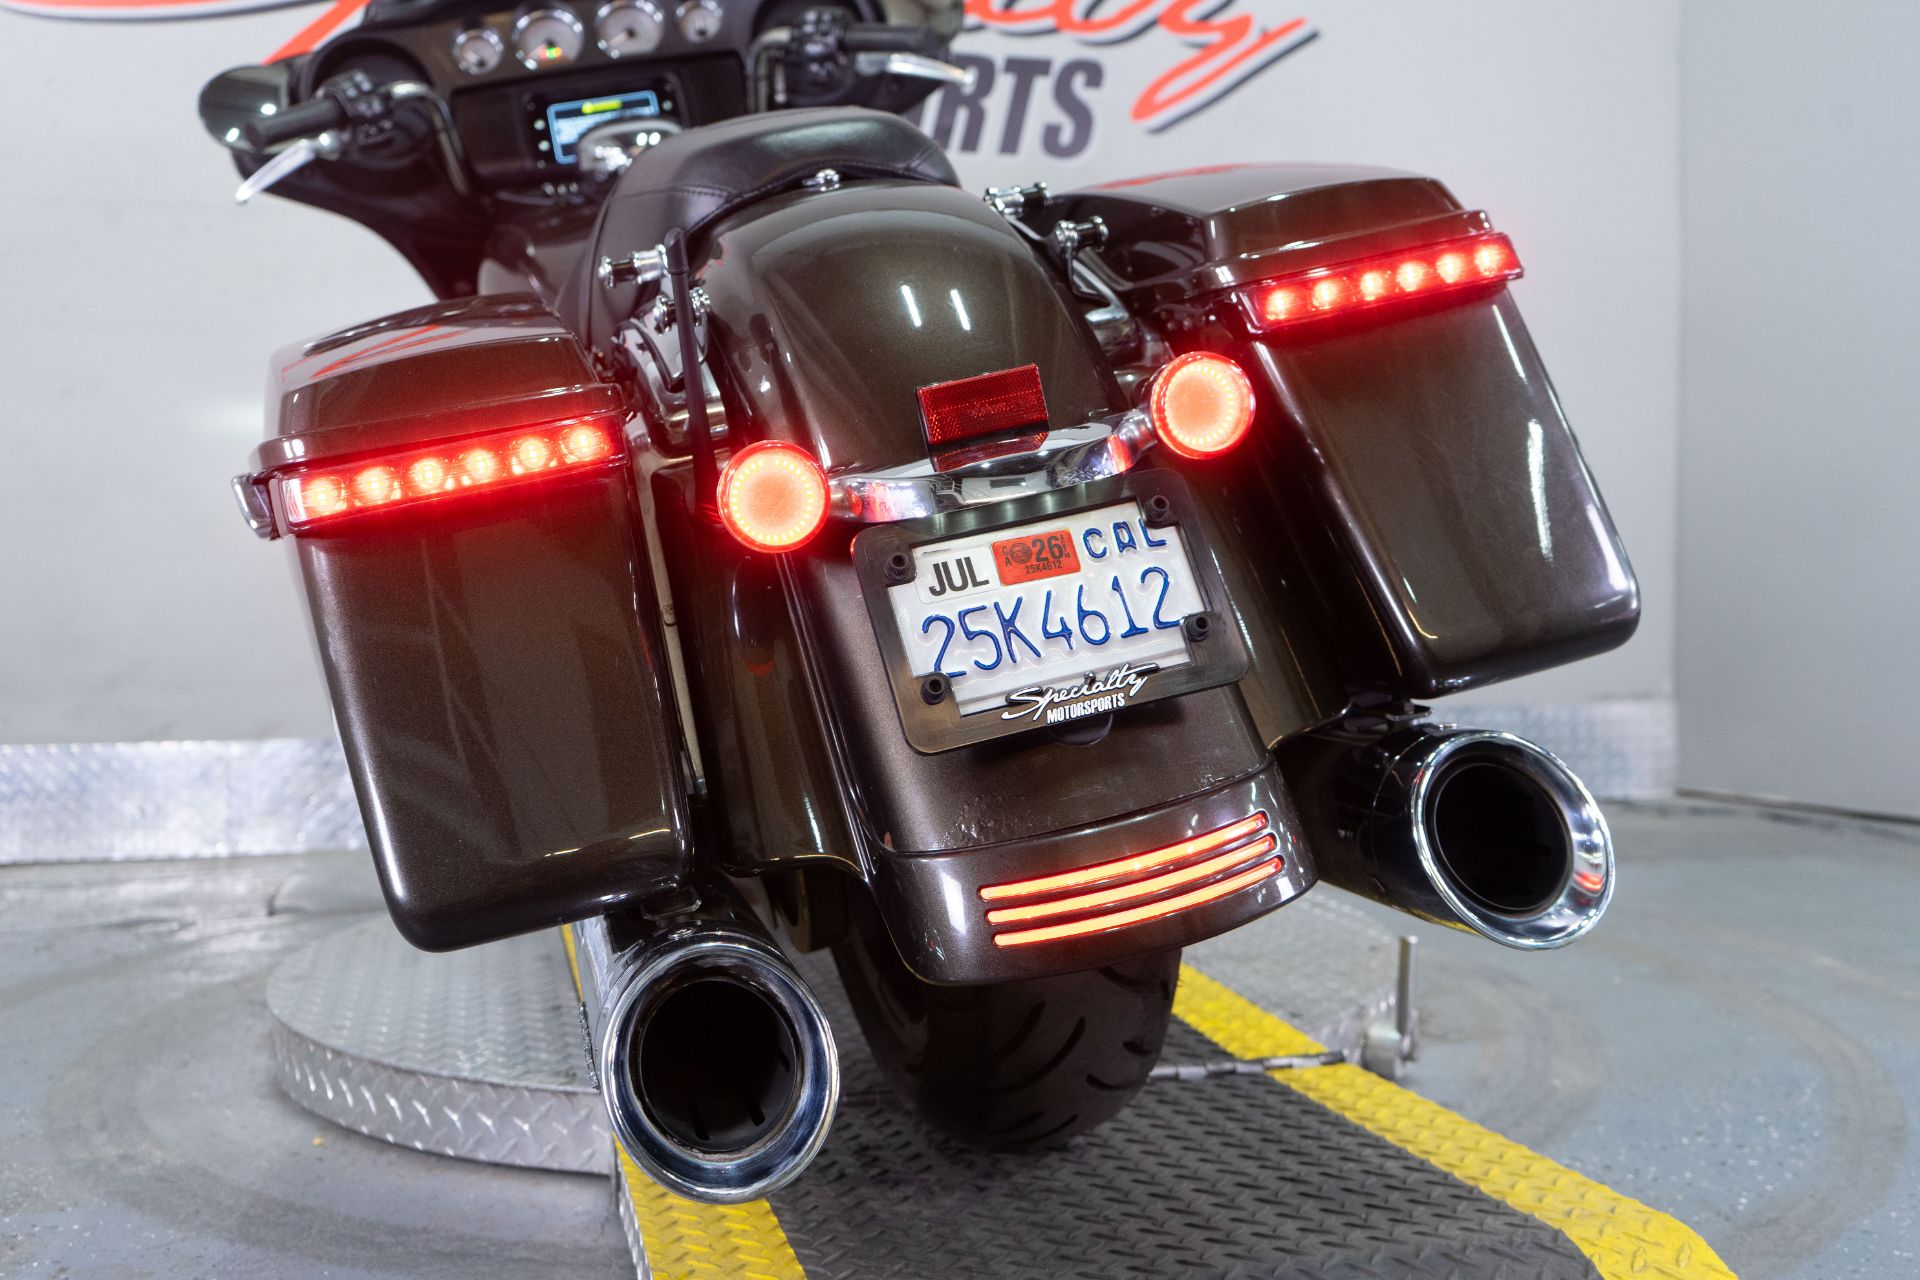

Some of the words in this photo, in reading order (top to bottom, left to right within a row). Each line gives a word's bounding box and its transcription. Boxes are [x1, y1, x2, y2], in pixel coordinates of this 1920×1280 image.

[1031, 535, 1064, 562] 26
[1082, 516, 1168, 560] CAL
[928, 556, 990, 597] JUL
[1024, 560, 1063, 575] 25K4612
[921, 566, 1182, 678] 25K4612
[1001, 662, 1158, 721] Specialty
[1046, 692, 1126, 724] MOTORSPORTS
